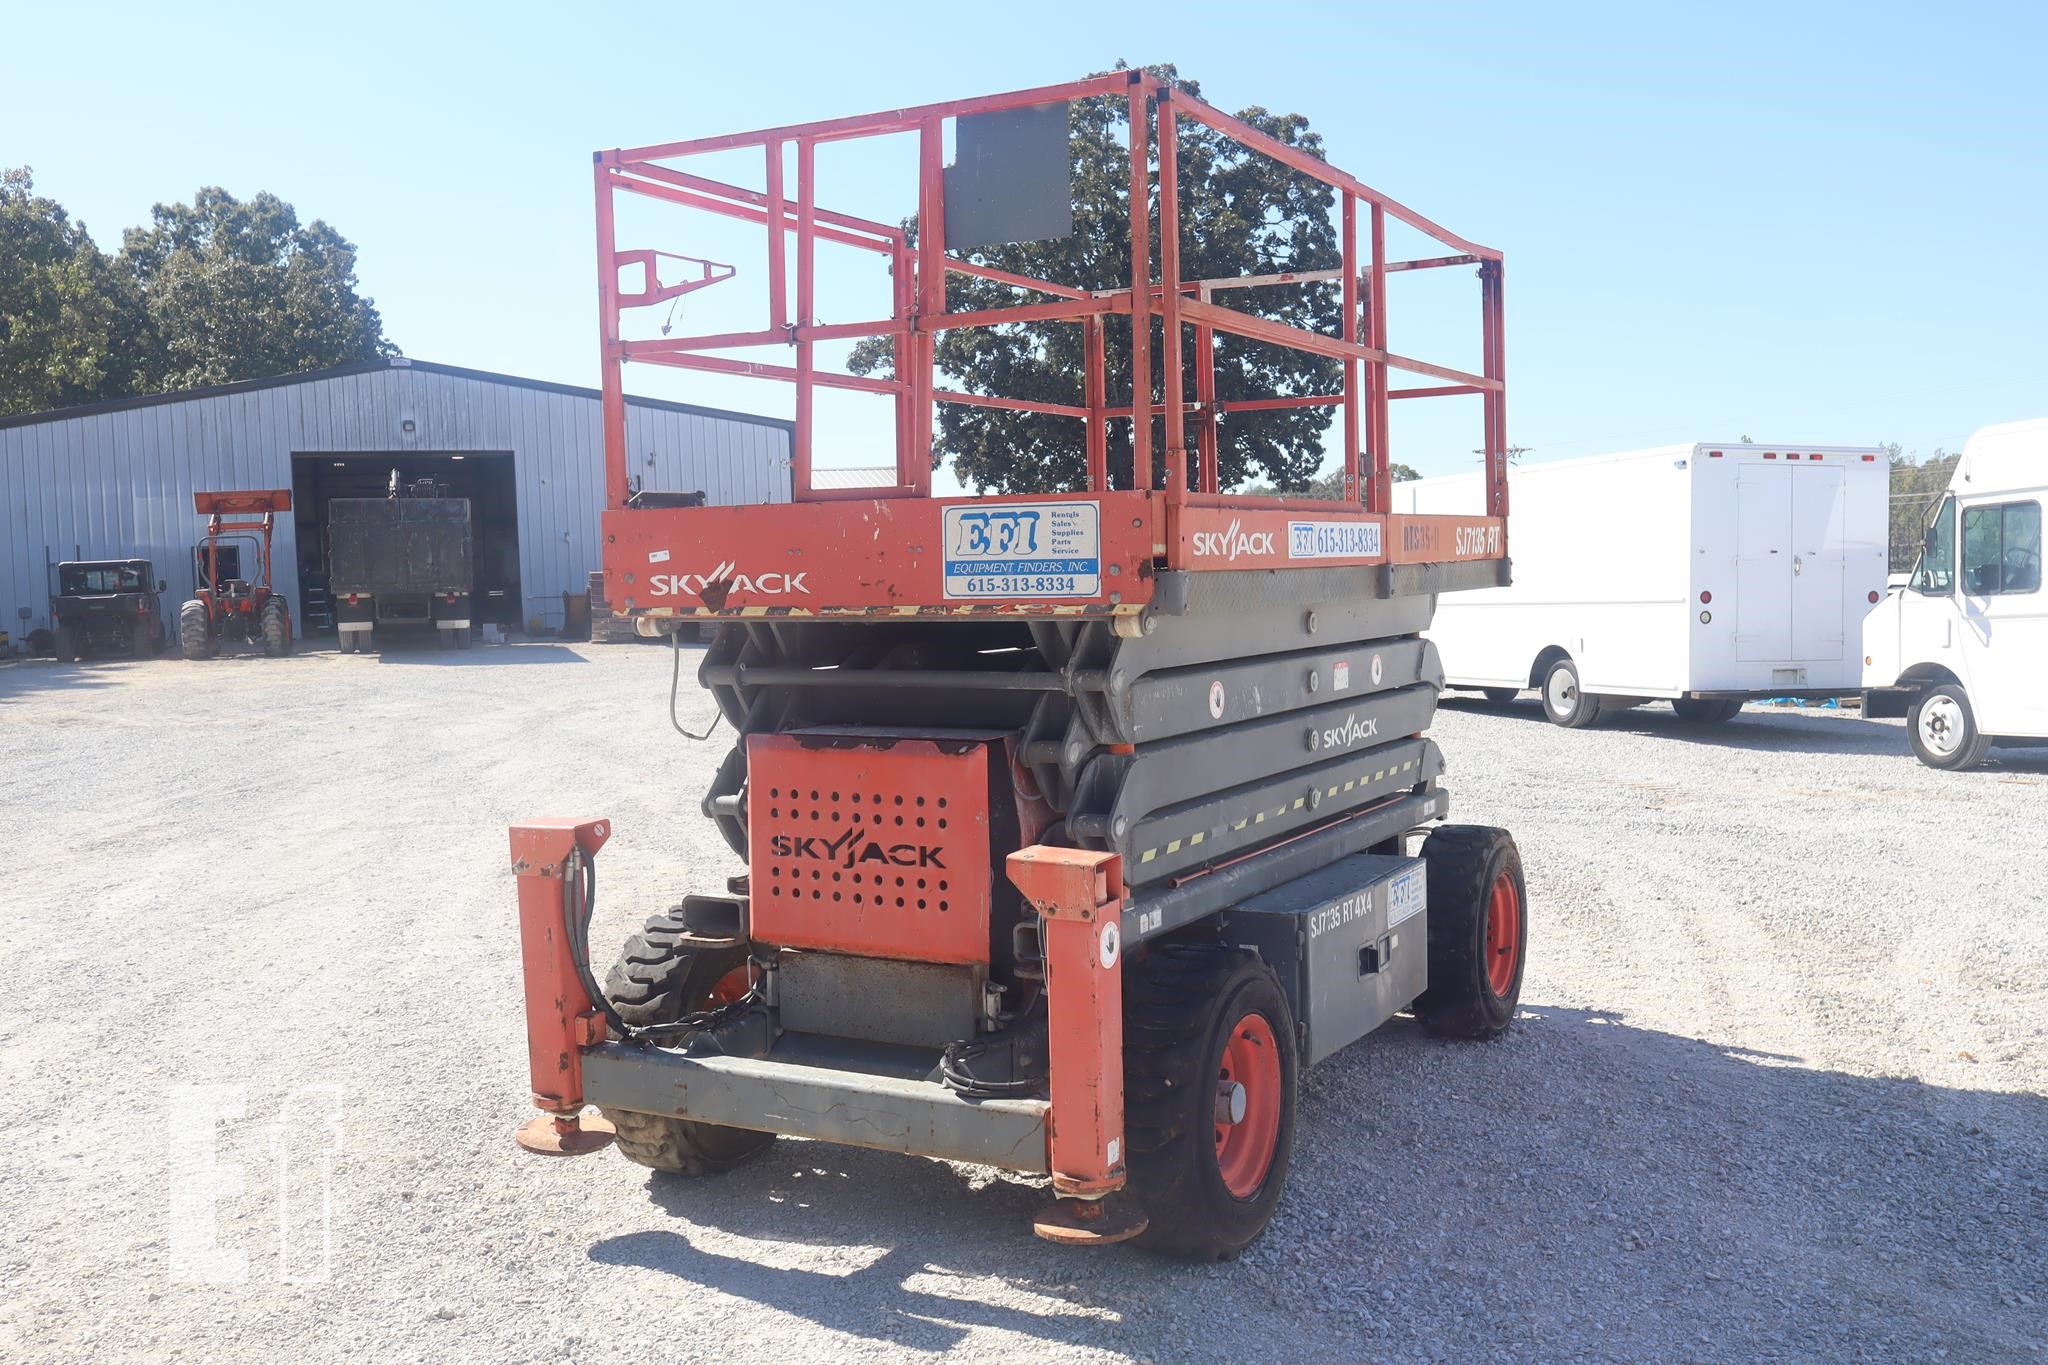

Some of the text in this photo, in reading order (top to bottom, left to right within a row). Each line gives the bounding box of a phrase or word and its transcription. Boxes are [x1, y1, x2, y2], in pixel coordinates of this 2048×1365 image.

[956, 511, 1040, 556] EFI
[1051, 529, 1084, 537] Supplies
[1193, 517, 1275, 561] SKYJACK
[1318, 527, 1378, 553] 615-313-8334
[1455, 526, 1500, 556] SJ7135 RT
[953, 561, 1089, 574] EQUIPMENT FINDERS, INC.
[967, 576, 1075, 593] 615-313-8334
[1323, 713, 1378, 748] SKYJACK
[771, 827, 947, 869] SKYJACK
[1343, 899, 1353, 923] RT
[1355, 891, 1372, 918] 4X4
